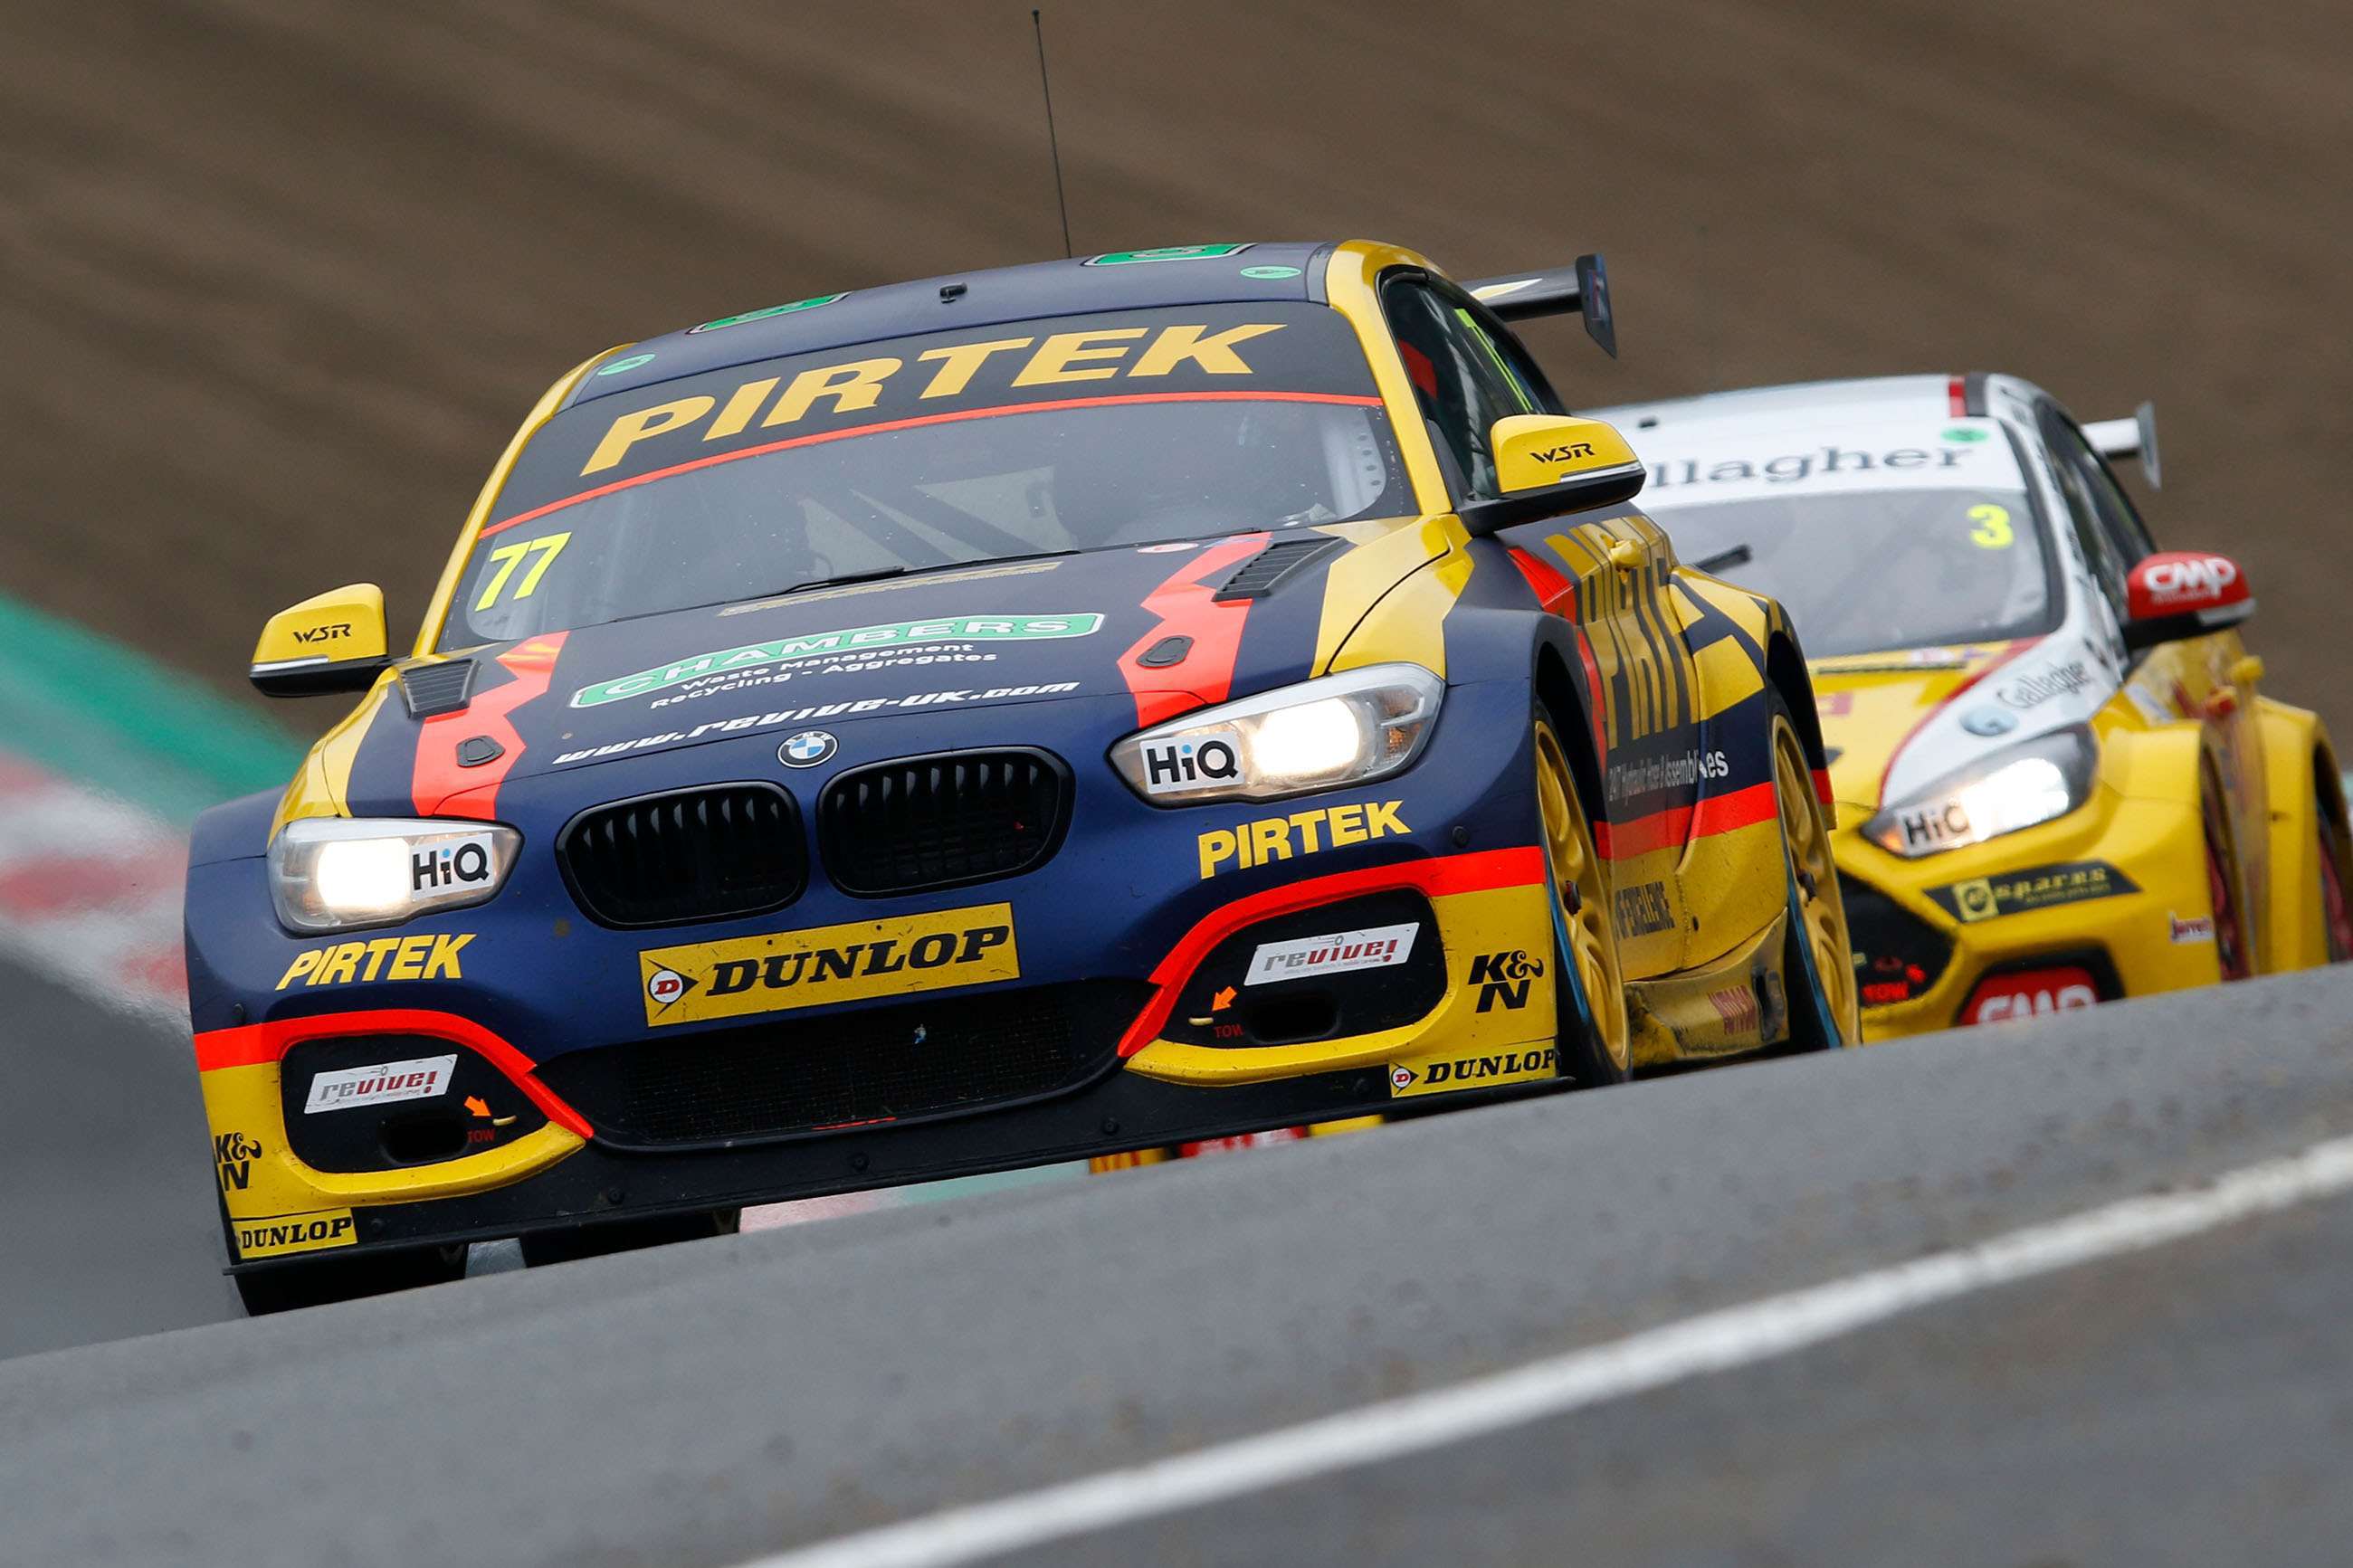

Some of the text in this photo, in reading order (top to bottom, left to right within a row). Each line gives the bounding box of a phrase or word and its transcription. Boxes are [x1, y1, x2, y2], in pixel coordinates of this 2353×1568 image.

[580, 323, 1286, 477] PIRTEK
[1529, 442, 1596, 463] WSR
[1643, 445, 1975, 487] llagher
[1967, 504, 2015, 548] 3
[474, 532, 572, 612] 77
[293, 622, 352, 644] WSR
[604, 618, 1066, 697] CHAMBERS
[681, 643, 975, 692] Waste Management
[650, 673, 792, 709] Recycling
[822, 652, 998, 674] Aggregates
[1147, 740, 1239, 785] HiQ
[1197, 800, 1412, 879] PIRTEK
[412, 842, 489, 890] HiQ
[274, 934, 477, 991] PIRTEK
[706, 926, 1010, 996] DUNLOP
[1263, 939, 1398, 972] revive!
[1475, 980, 1530, 1012] N
[319, 1071, 438, 1101] revive!
[1424, 1049, 1555, 1085] DUNLOP
[242, 1216, 352, 1250] DUNLOP
